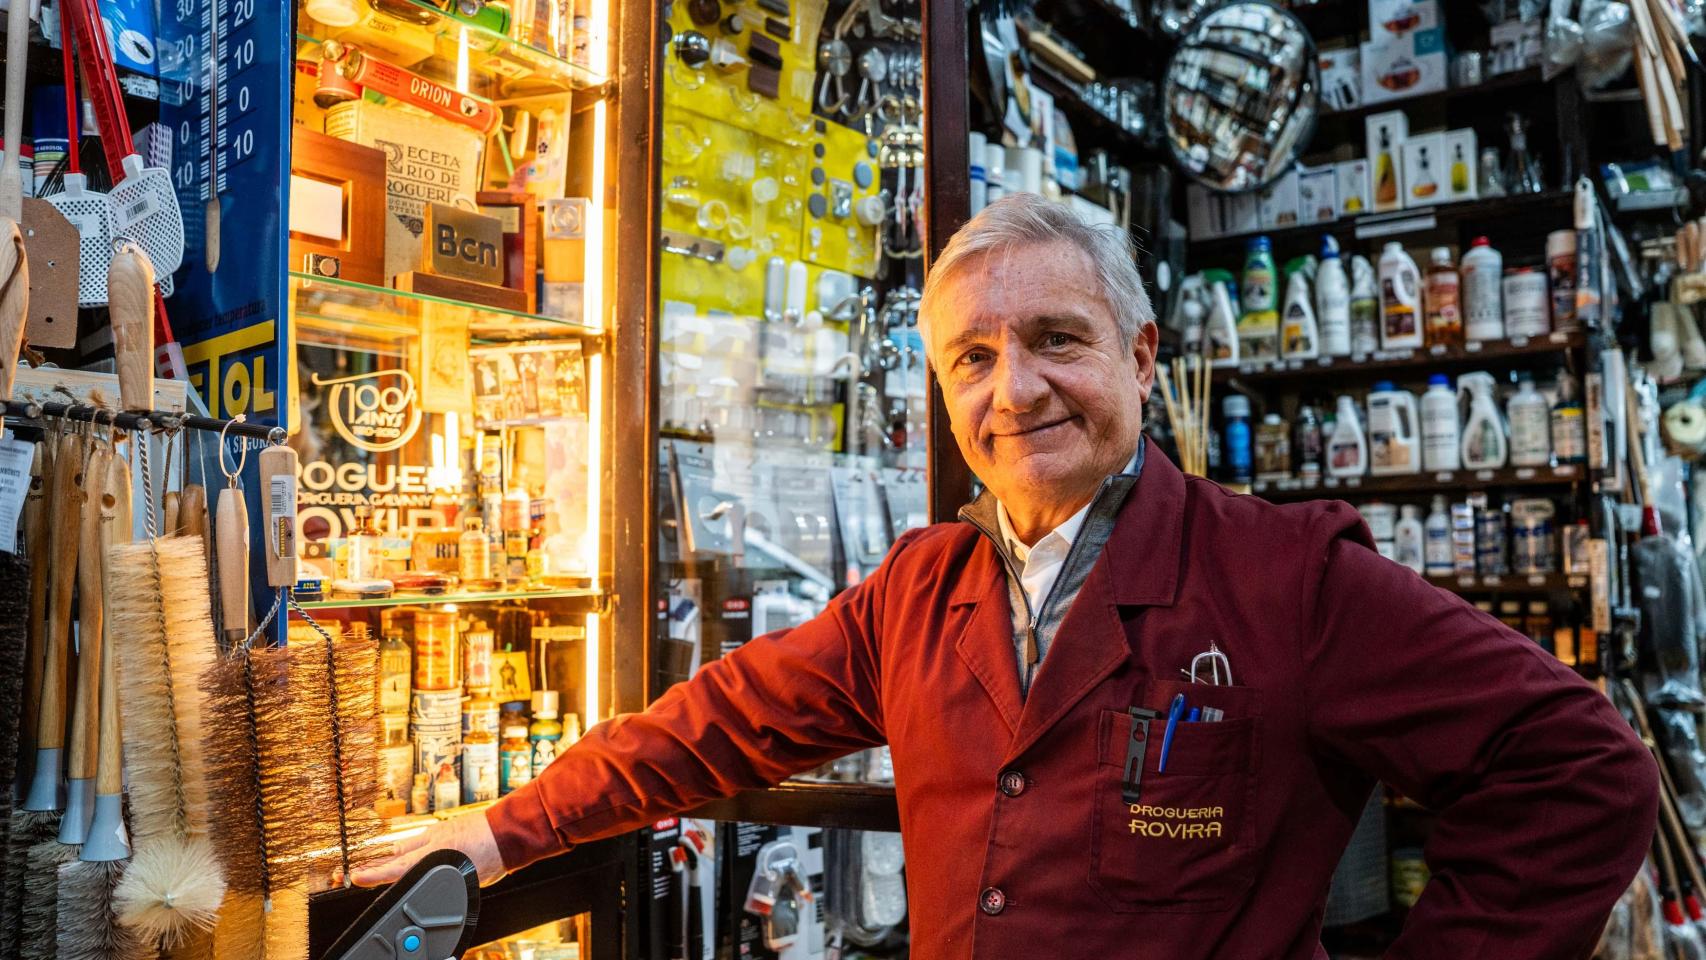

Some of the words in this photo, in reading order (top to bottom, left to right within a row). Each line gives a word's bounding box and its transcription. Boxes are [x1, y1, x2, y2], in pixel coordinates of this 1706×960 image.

[176, 0, 194, 22] 30
[234, 0, 254, 28] 20
[175, 34, 194, 64] 20
[234, 39, 254, 70] 10
[176, 77, 194, 105] 10
[239, 86, 249, 112] 0
[411, 77, 452, 107] ORION
[180, 121, 190, 145] 0
[234, 129, 254, 160] 10
[175, 161, 193, 189] 10
[407, 164, 435, 181] RIO
[440, 172, 461, 187] DE
[437, 223, 498, 267] Bcn
[1129, 804, 1224, 819] DROGUERIA
[1128, 819, 1222, 840] ROVIRA
